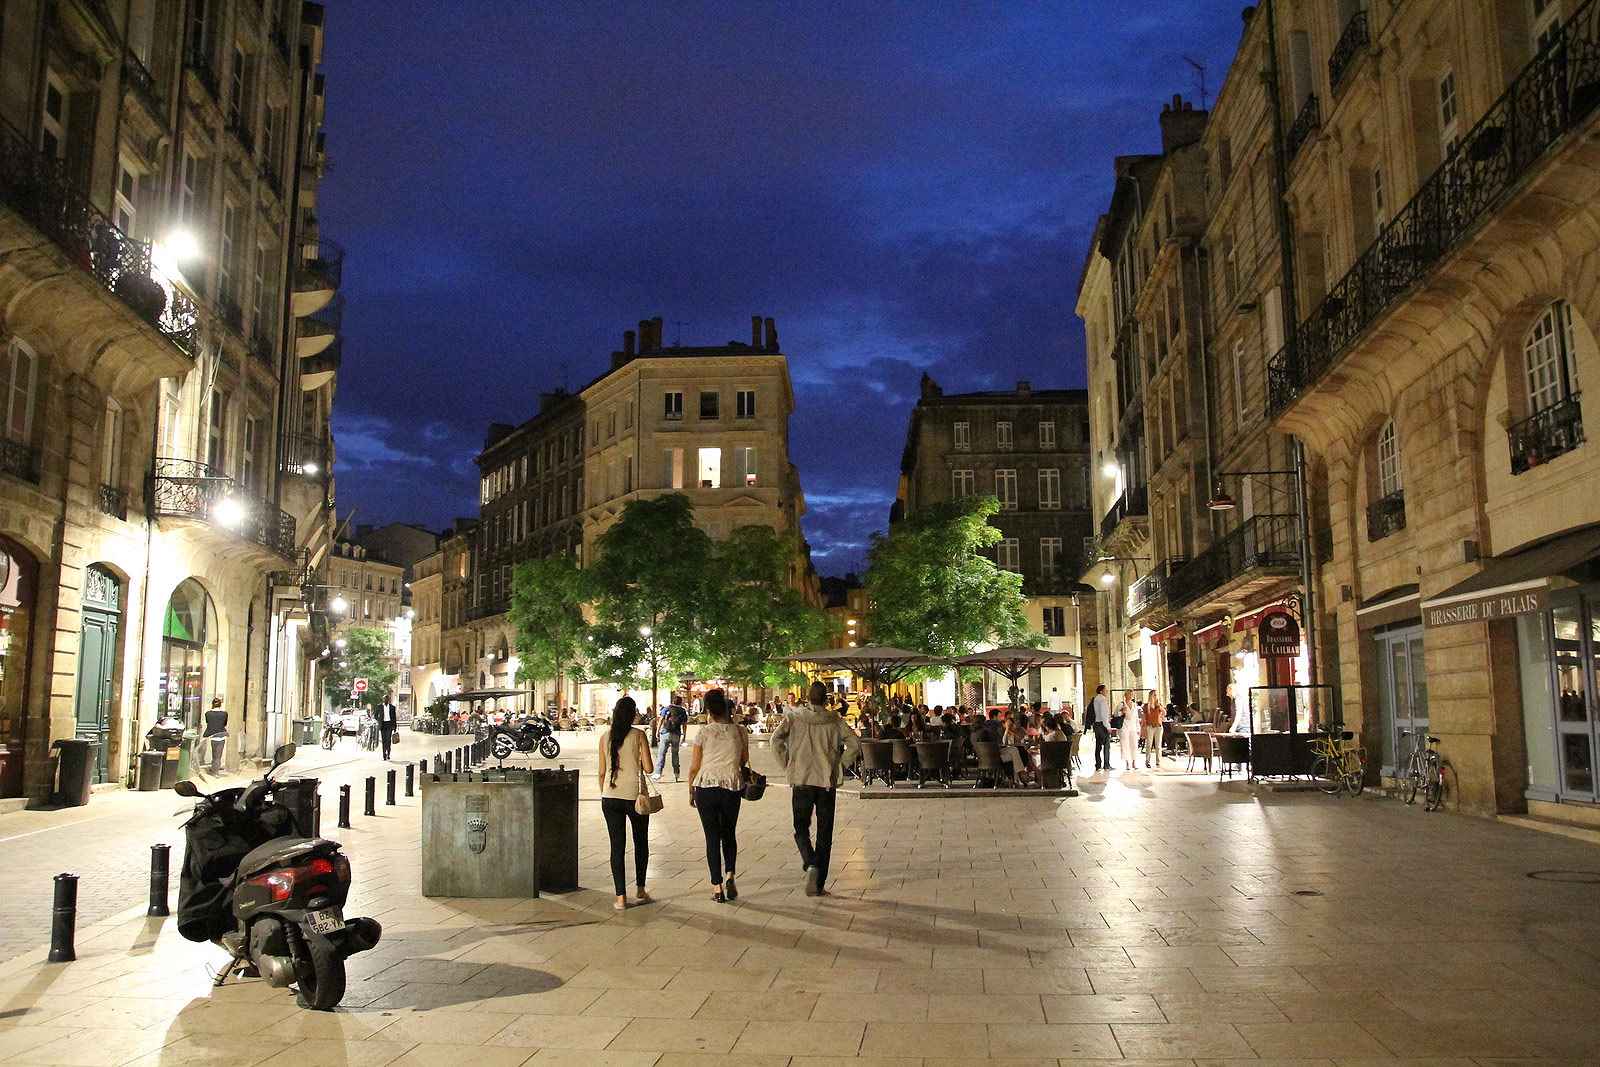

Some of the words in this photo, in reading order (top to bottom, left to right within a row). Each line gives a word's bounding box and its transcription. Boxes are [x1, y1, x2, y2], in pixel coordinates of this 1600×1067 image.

[1430, 603, 1478, 625] BRASSERIE
[1482, 601, 1496, 618] DU
[1500, 594, 1538, 615] PALAIS
